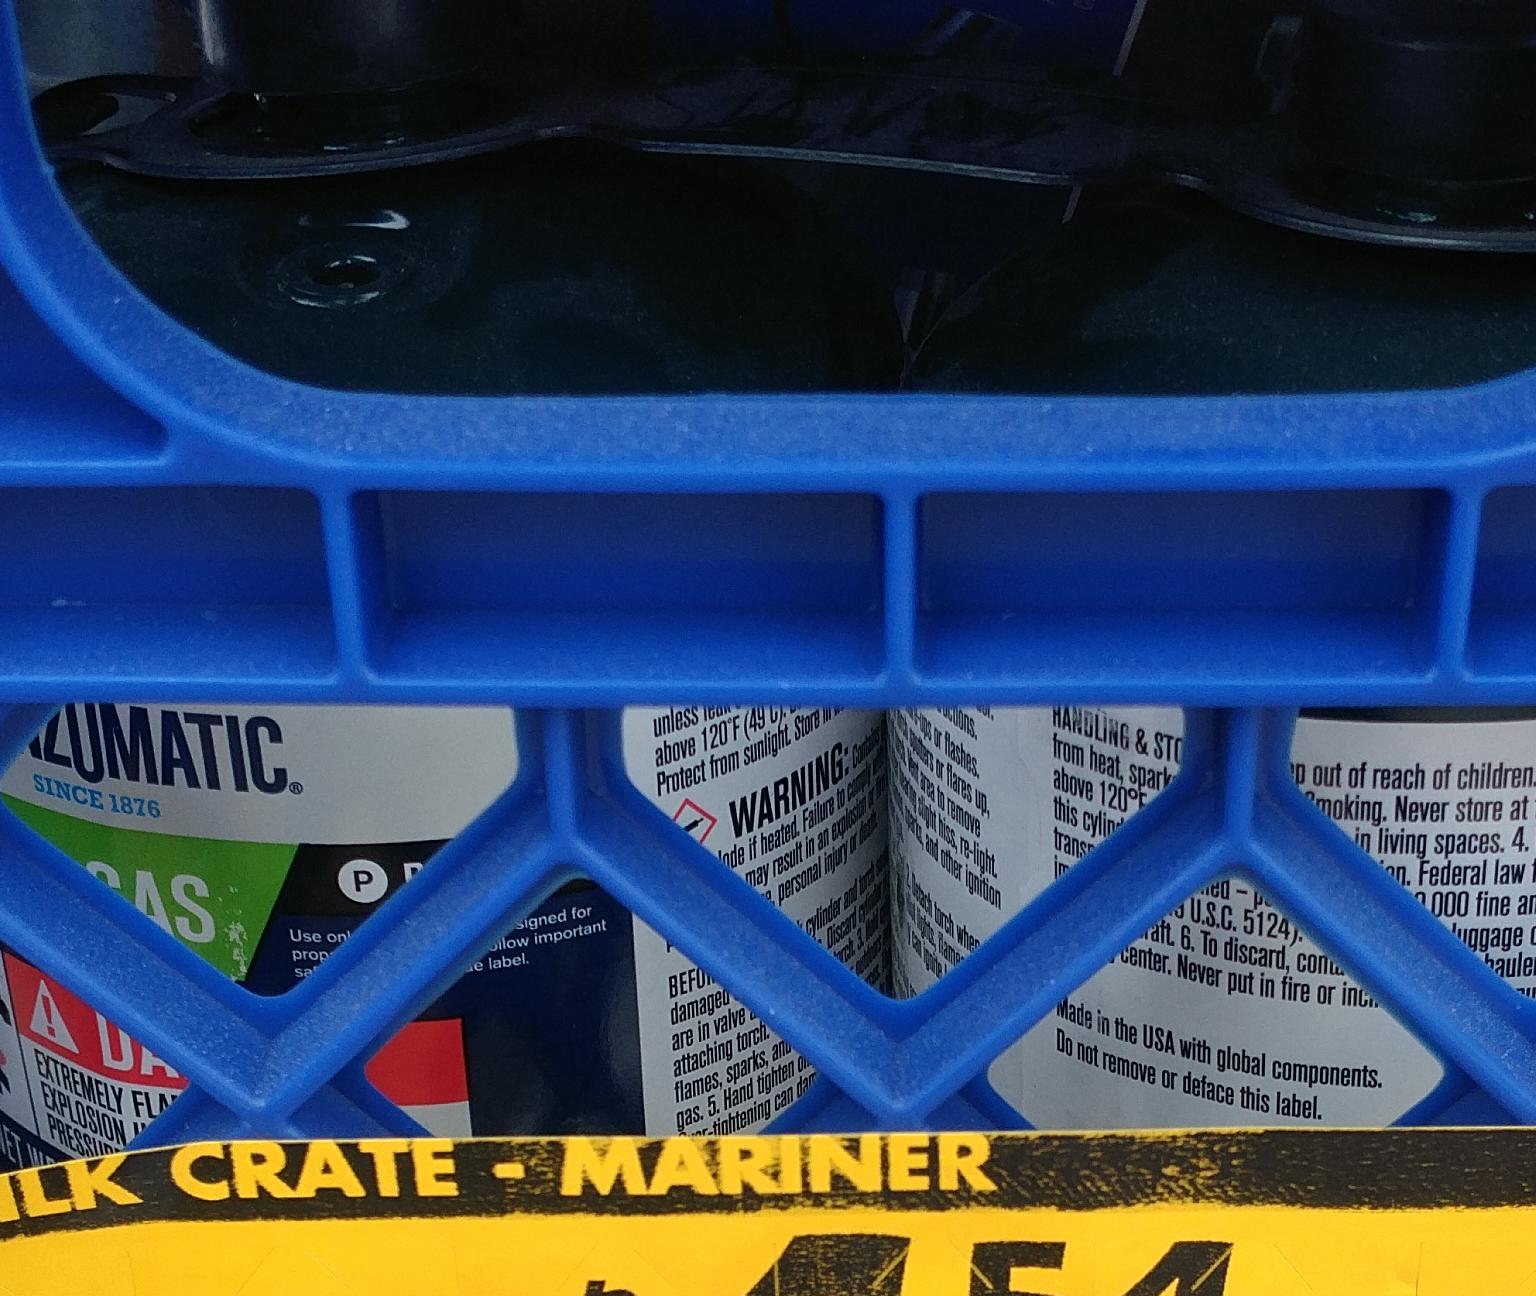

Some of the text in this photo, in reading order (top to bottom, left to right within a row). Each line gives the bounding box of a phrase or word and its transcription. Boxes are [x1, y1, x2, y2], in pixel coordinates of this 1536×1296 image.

[653, 705, 698, 737] unless
[655, 715, 739, 767] above 120°F
[1052, 705, 1149, 757] HANDLING &
[28, 703, 289, 794] ZOMATIC
[657, 709, 820, 797] Protect from sunlight. Store
[933, 727, 980, 780] or flashes.
[1052, 732, 1124, 785] from heat,
[33, 774, 162, 819] SINCE 1876
[729, 741, 850, 838] WARNING:
[936, 757, 990, 819] or flares up,
[1053, 767, 1093, 801] above
[1312, 763, 1342, 788] out
[1348, 761, 1368, 790] of
[1372, 762, 1425, 791] reach
[1432, 763, 1452, 791] of
[749, 787, 845, 861] if heated. Failure to
[920, 771, 935, 803] area
[937, 785, 946, 812] to
[947, 798, 981, 838] remove
[1053, 796, 1078, 828] this
[1394, 795, 1449, 823] Never
[1454, 798, 1503, 823] store
[1510, 798, 1529, 821] at
[745, 798, 868, 888] may result in an explosion
[938, 813, 998, 879] hiss, re-light.
[1377, 826, 1427, 859] living
[1433, 830, 1505, 860] spaces.
[1511, 827, 1530, 853] 4.
[353, 869, 375, 893] P
[778, 855, 822, 907] personal
[824, 840, 848, 876] injury
[850, 836, 857, 854] or
[925, 833, 1002, 910] and other ignition
[1419, 860, 1487, 887] Federal
[1493, 858, 1526, 885] law
[571, 904, 593, 920] for
[806, 895, 843, 937] cylinder
[844, 878, 858, 908] and
[827, 906, 857, 950] Discard
[934, 901, 955, 940] torch
[1190, 897, 1237, 932] U.S.C.
[1243, 908, 1303, 948] 5124).
[1475, 890, 1511, 917] fine
[289, 927, 322, 944] Use
[534, 919, 608, 948] important
[1180, 925, 1290, 975] 6. To discard,
[488, 953, 529, 971] label.
[1120, 946, 1336, 1006] center. Never put in fire or
[672, 1029, 694, 1051] are
[698, 1021, 710, 1043] in
[713, 1006, 746, 1037] valve
[674, 1023, 770, 1078] attaching torch.
[1056, 997, 1383, 1091] Made in the USA with global components.
[34, 1048, 178, 1119] EXTREMELY FLA
[674, 1051, 769, 1103] flames, sparks,
[676, 1062, 796, 1132] gas. 5. Hand tighten
[1056, 1026, 1323, 1121] Do not remove or deface this label.
[40, 1080, 126, 1146] EXPLOSION
[774, 1088, 795, 1112] can
[171, 1140, 460, 1201] CRATE
[561, 1134, 997, 1197] MARINER
